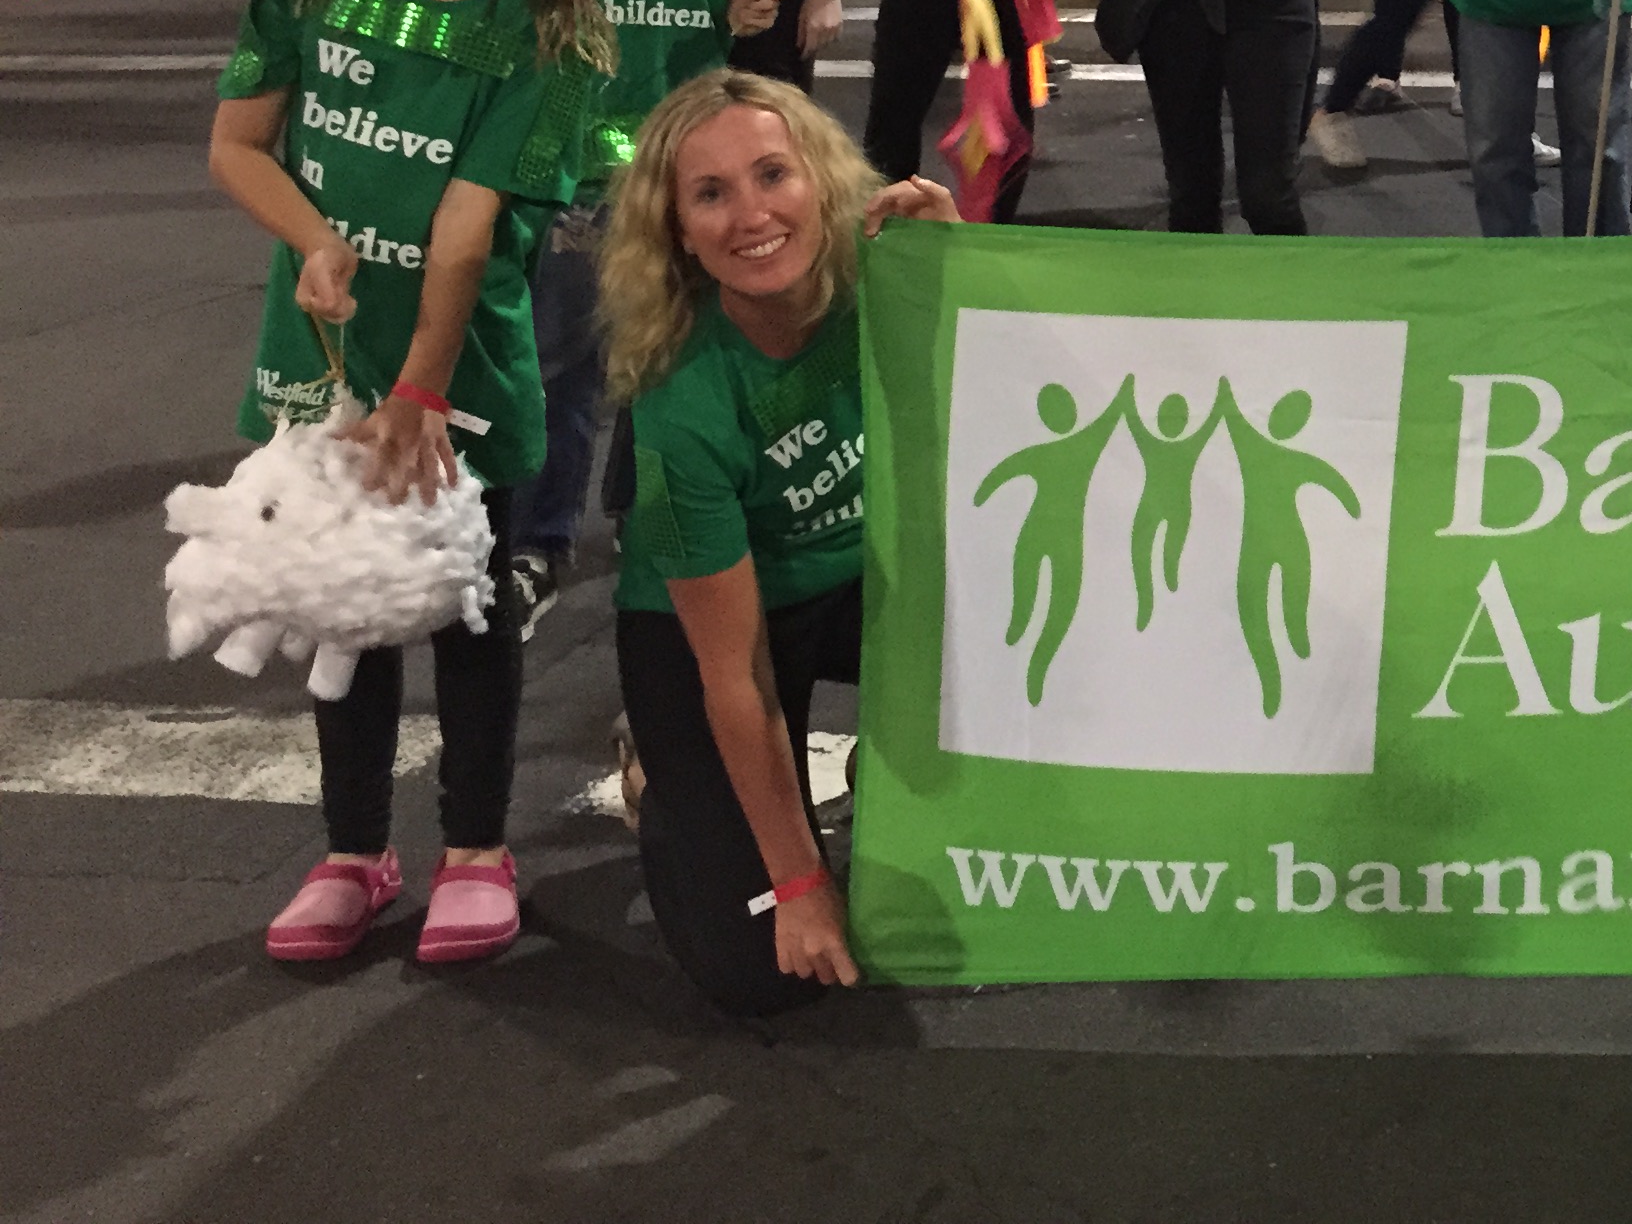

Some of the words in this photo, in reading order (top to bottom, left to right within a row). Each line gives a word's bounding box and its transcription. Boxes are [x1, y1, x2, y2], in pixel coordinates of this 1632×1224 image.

[317, 38, 375, 85] We
[303, 92, 454, 165] believe
[764, 419, 828, 469] We
